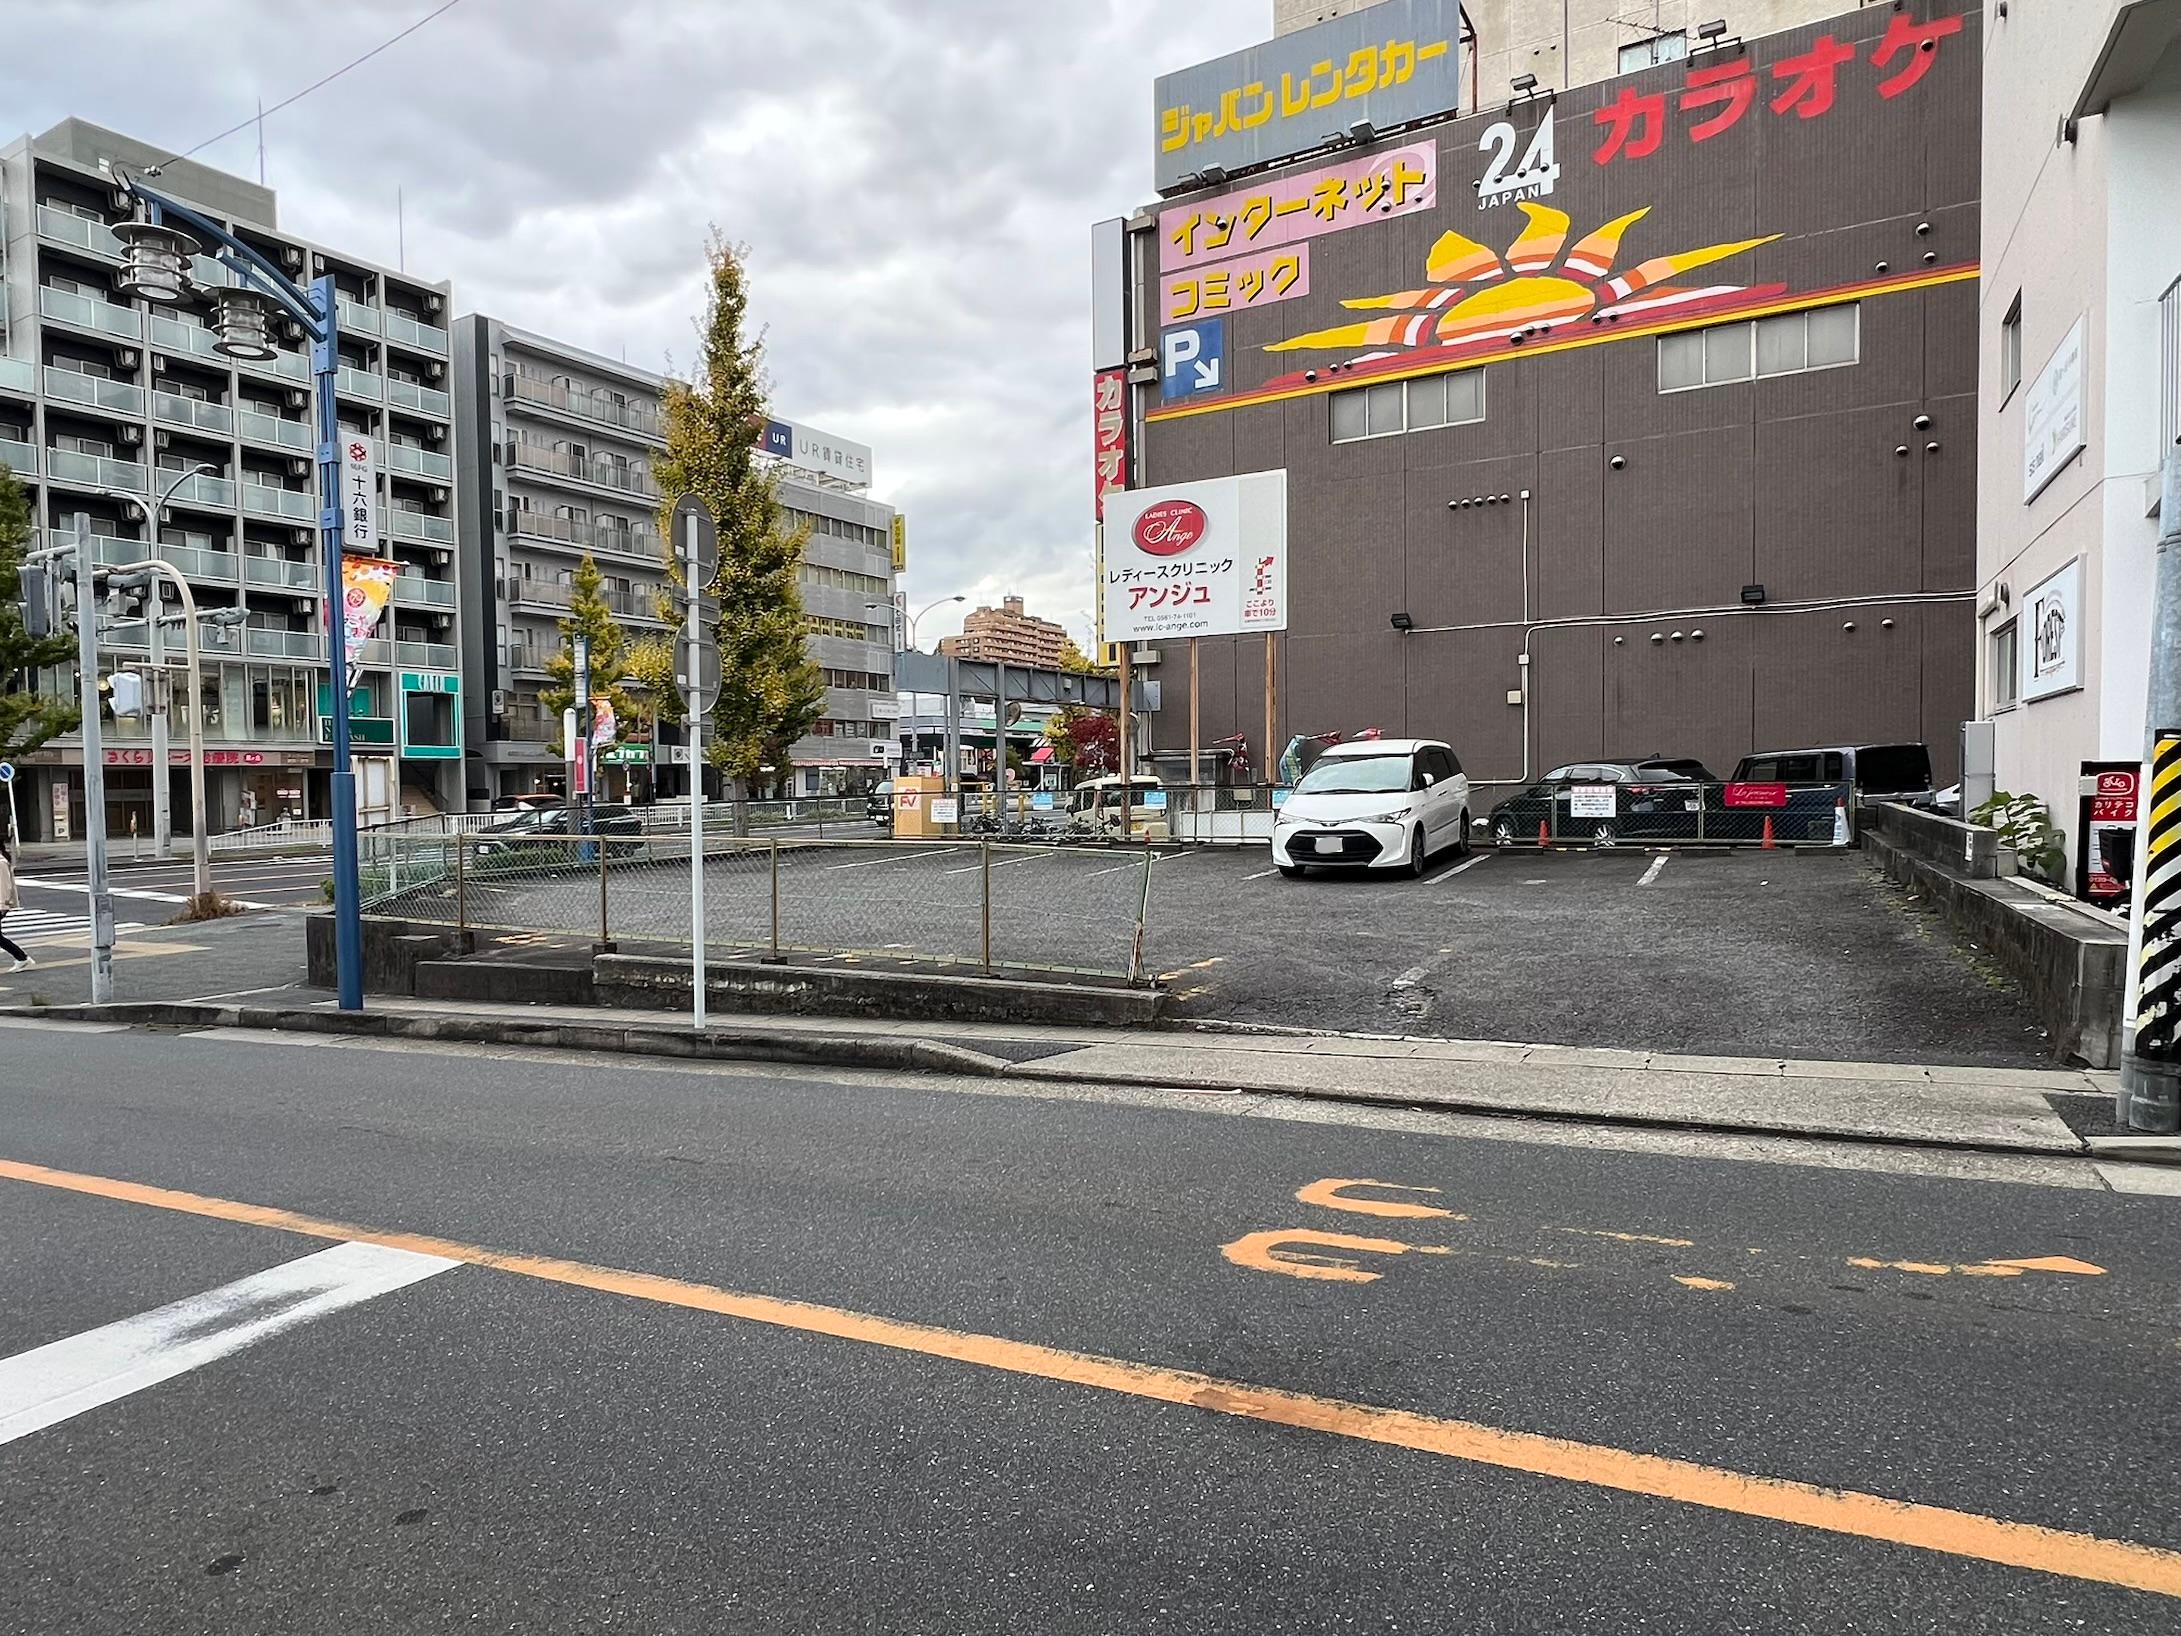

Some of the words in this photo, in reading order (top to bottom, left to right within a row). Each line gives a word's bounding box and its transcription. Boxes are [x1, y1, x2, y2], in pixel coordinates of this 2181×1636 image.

[1161, 39, 1448, 153] ジャパンレンタカー
[1592, 13, 1964, 166] カラオケ
[1477, 103, 1562, 198] 24
[1172, 160, 1426, 255] インターネット
[1477, 184, 1542, 211] JAPAN
[1170, 254, 1300, 319] コミック
[1164, 329, 1201, 378] P
[772, 432, 787, 446] UR
[352, 475, 369, 539] 十六銀行
[1145, 511, 1167, 520] LADIES
[1170, 506, 1193, 516] CLINIC
[1142, 516, 1194, 547] Ange
[1109, 558, 1234, 584] レディースクリニック
[1128, 581, 1211, 610] アンジュ
[1246, 599, 1275, 608] ここより
[2093, 809, 2133, 817] バイク
[2094, 801, 2134, 809] カリテコ
